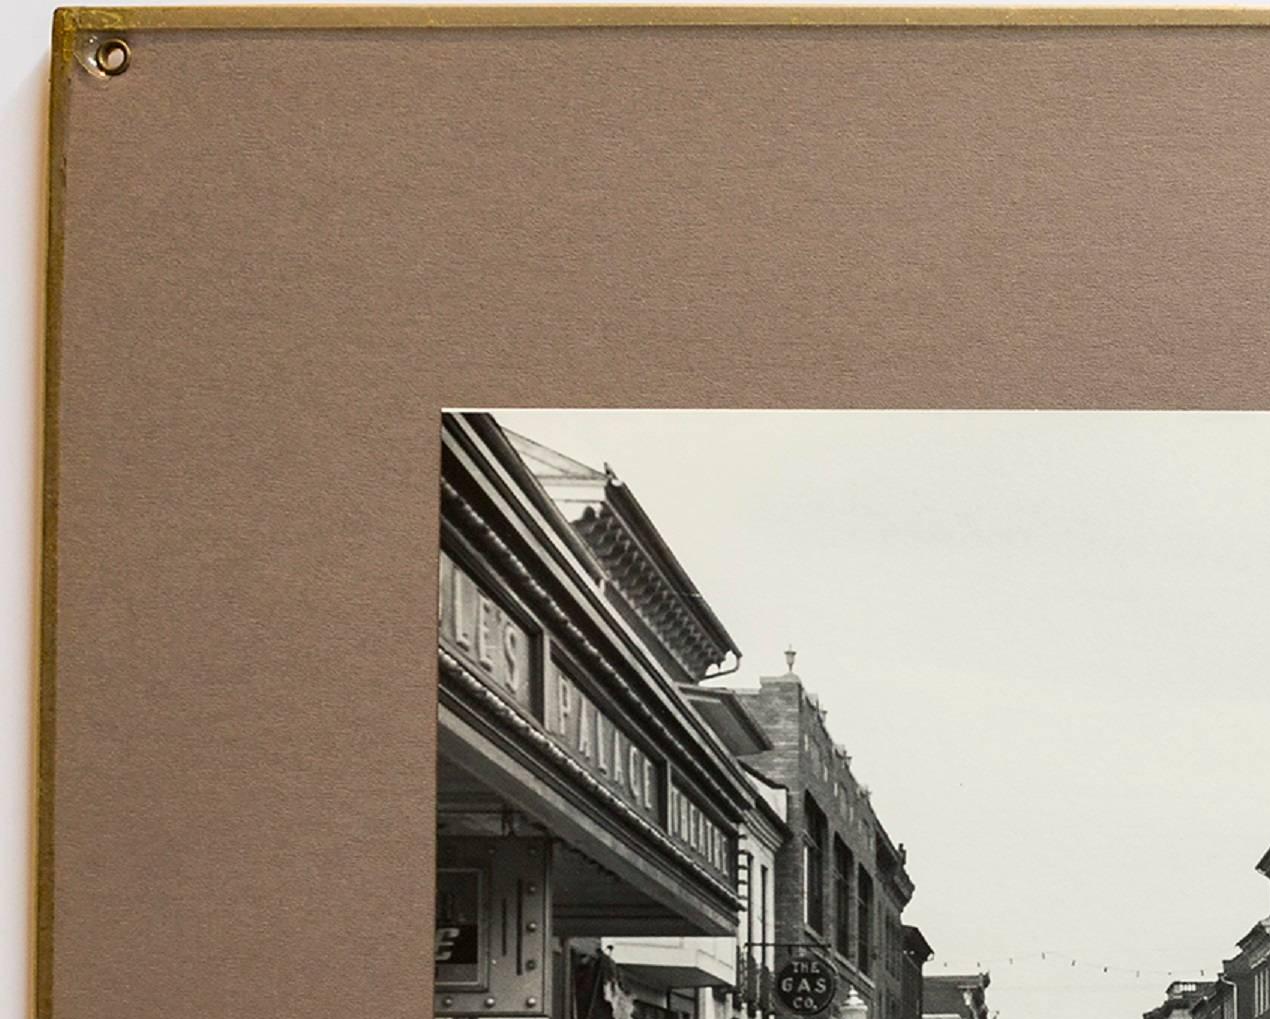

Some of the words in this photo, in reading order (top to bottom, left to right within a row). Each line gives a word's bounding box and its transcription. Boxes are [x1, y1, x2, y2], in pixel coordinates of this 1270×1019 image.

[440, 562, 521, 694] LES
[791, 960, 820, 974] THE
[781, 977, 827, 994] GAS
[792, 996, 818, 1009] CO.
